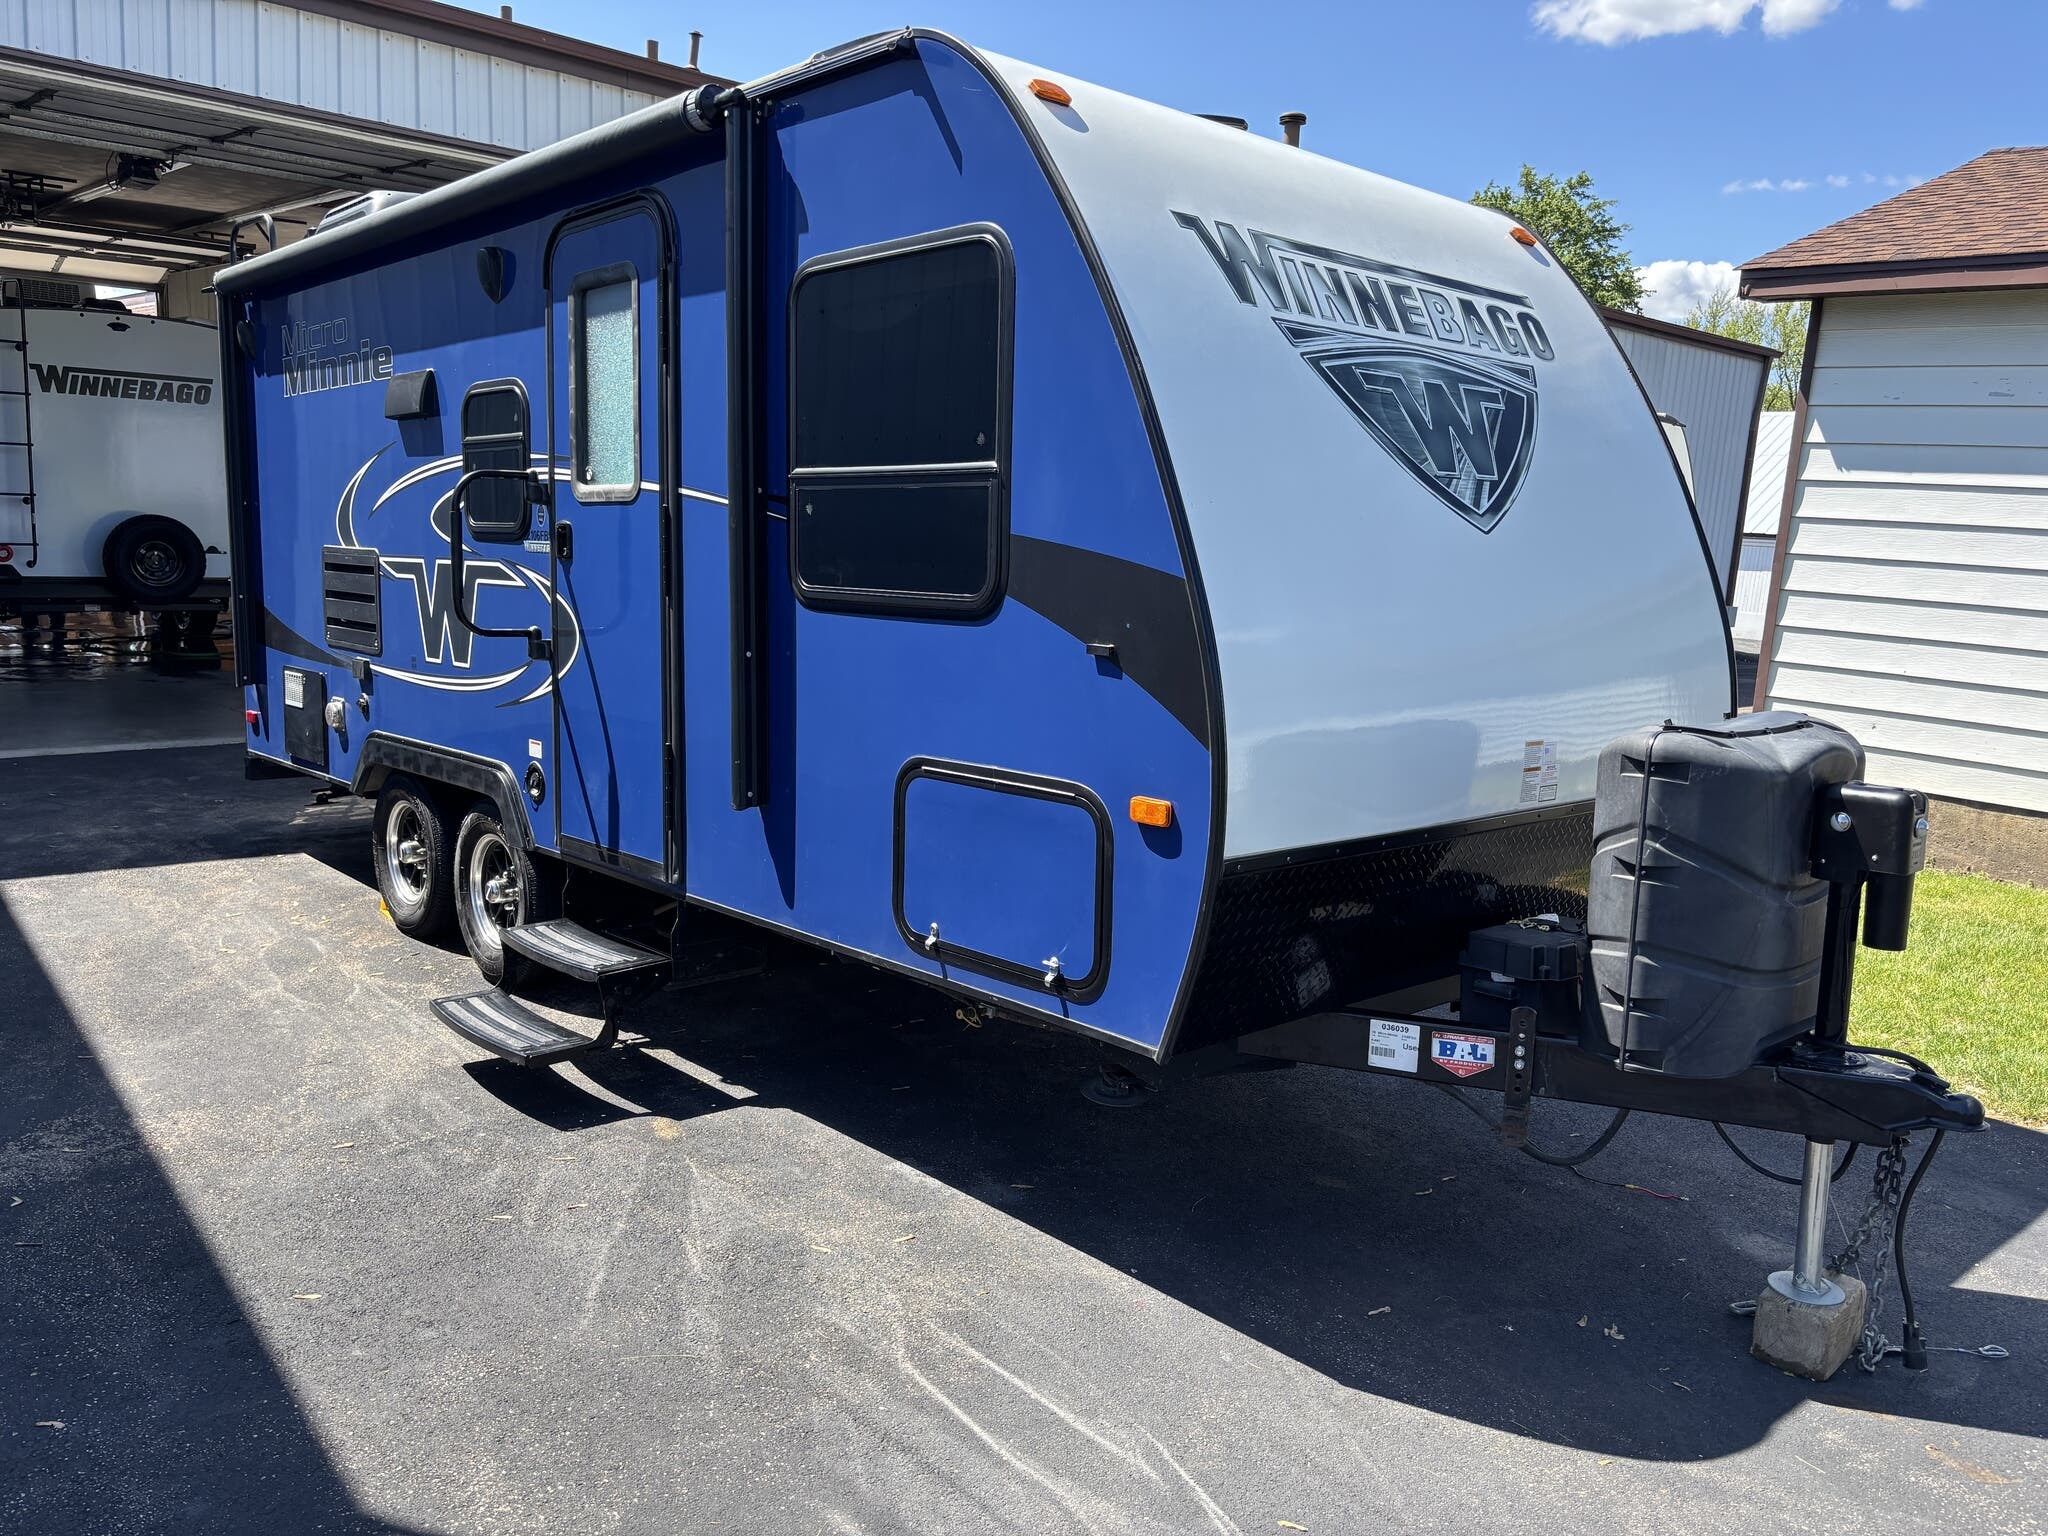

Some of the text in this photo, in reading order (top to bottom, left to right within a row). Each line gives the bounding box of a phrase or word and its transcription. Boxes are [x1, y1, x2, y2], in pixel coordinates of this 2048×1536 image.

[1168, 210, 1556, 362] WINNEBAGO
[281, 317, 348, 353] Micro
[29, 363, 214, 406] WINNEBAGO
[282, 338, 394, 399] Minnie
[1353, 366, 1506, 482] W
[1381, 1023, 1410, 1034] 036039
